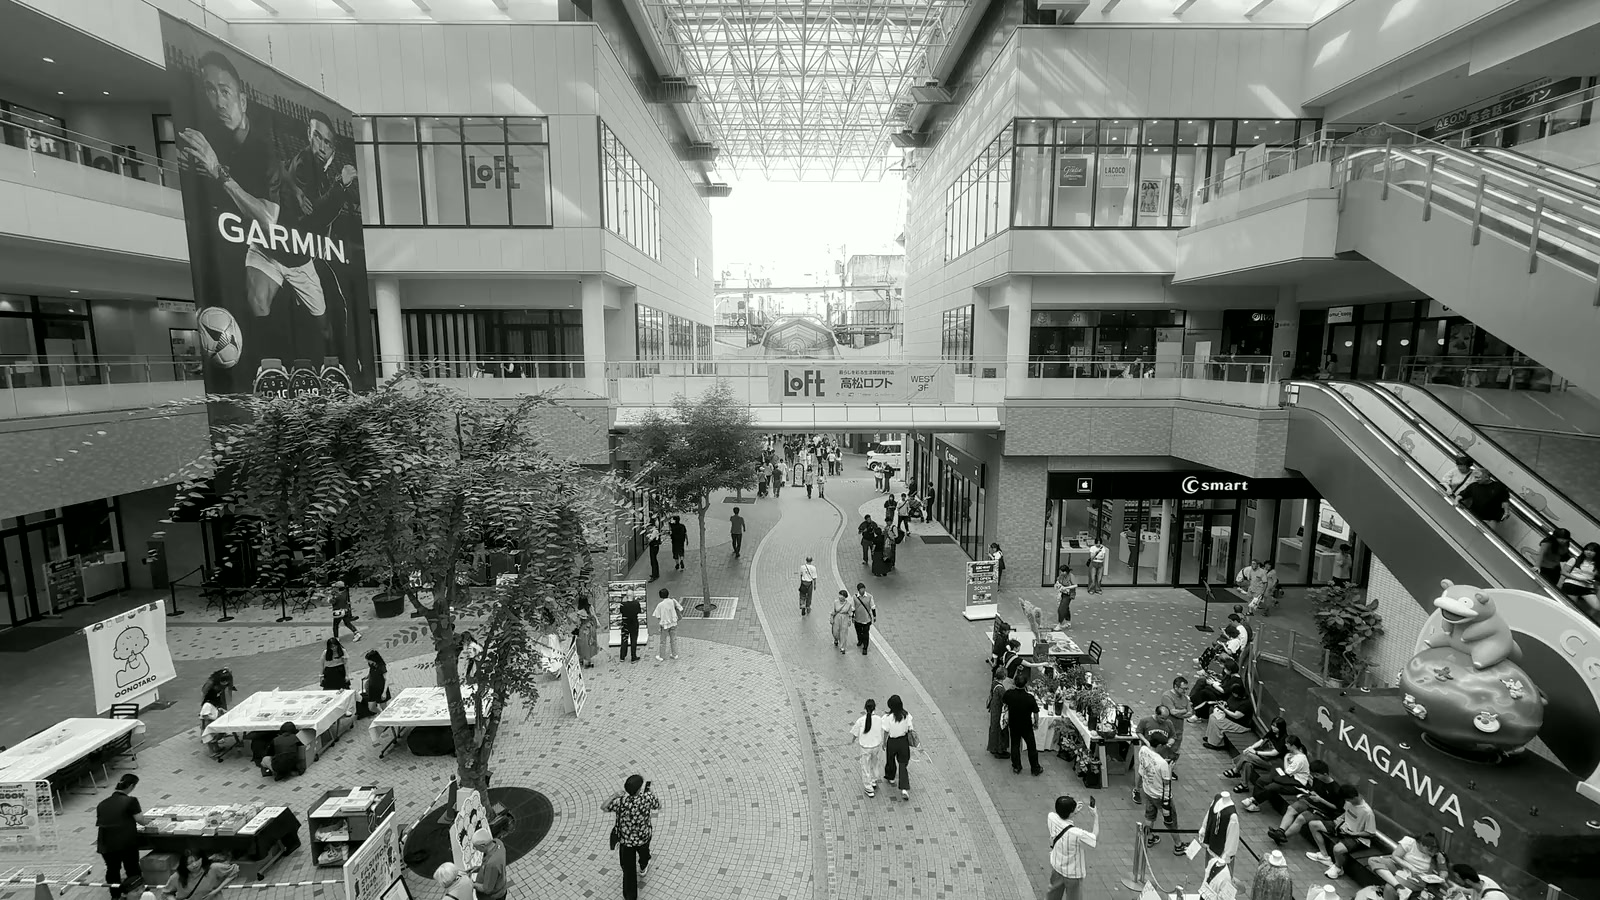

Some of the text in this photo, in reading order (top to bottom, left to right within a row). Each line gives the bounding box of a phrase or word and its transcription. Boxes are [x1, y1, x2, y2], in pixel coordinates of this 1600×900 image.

[1435, 110, 1467, 131] AEON
[840, 377, 893, 389] 高松ロフト
[910, 375, 935, 383] WEST
[917, 383, 929, 391] 3F
[1201, 481, 1249, 491] smart
[114, 675, 157, 698] OONOTARO
[1338, 719, 1464, 828] KAGAWA
